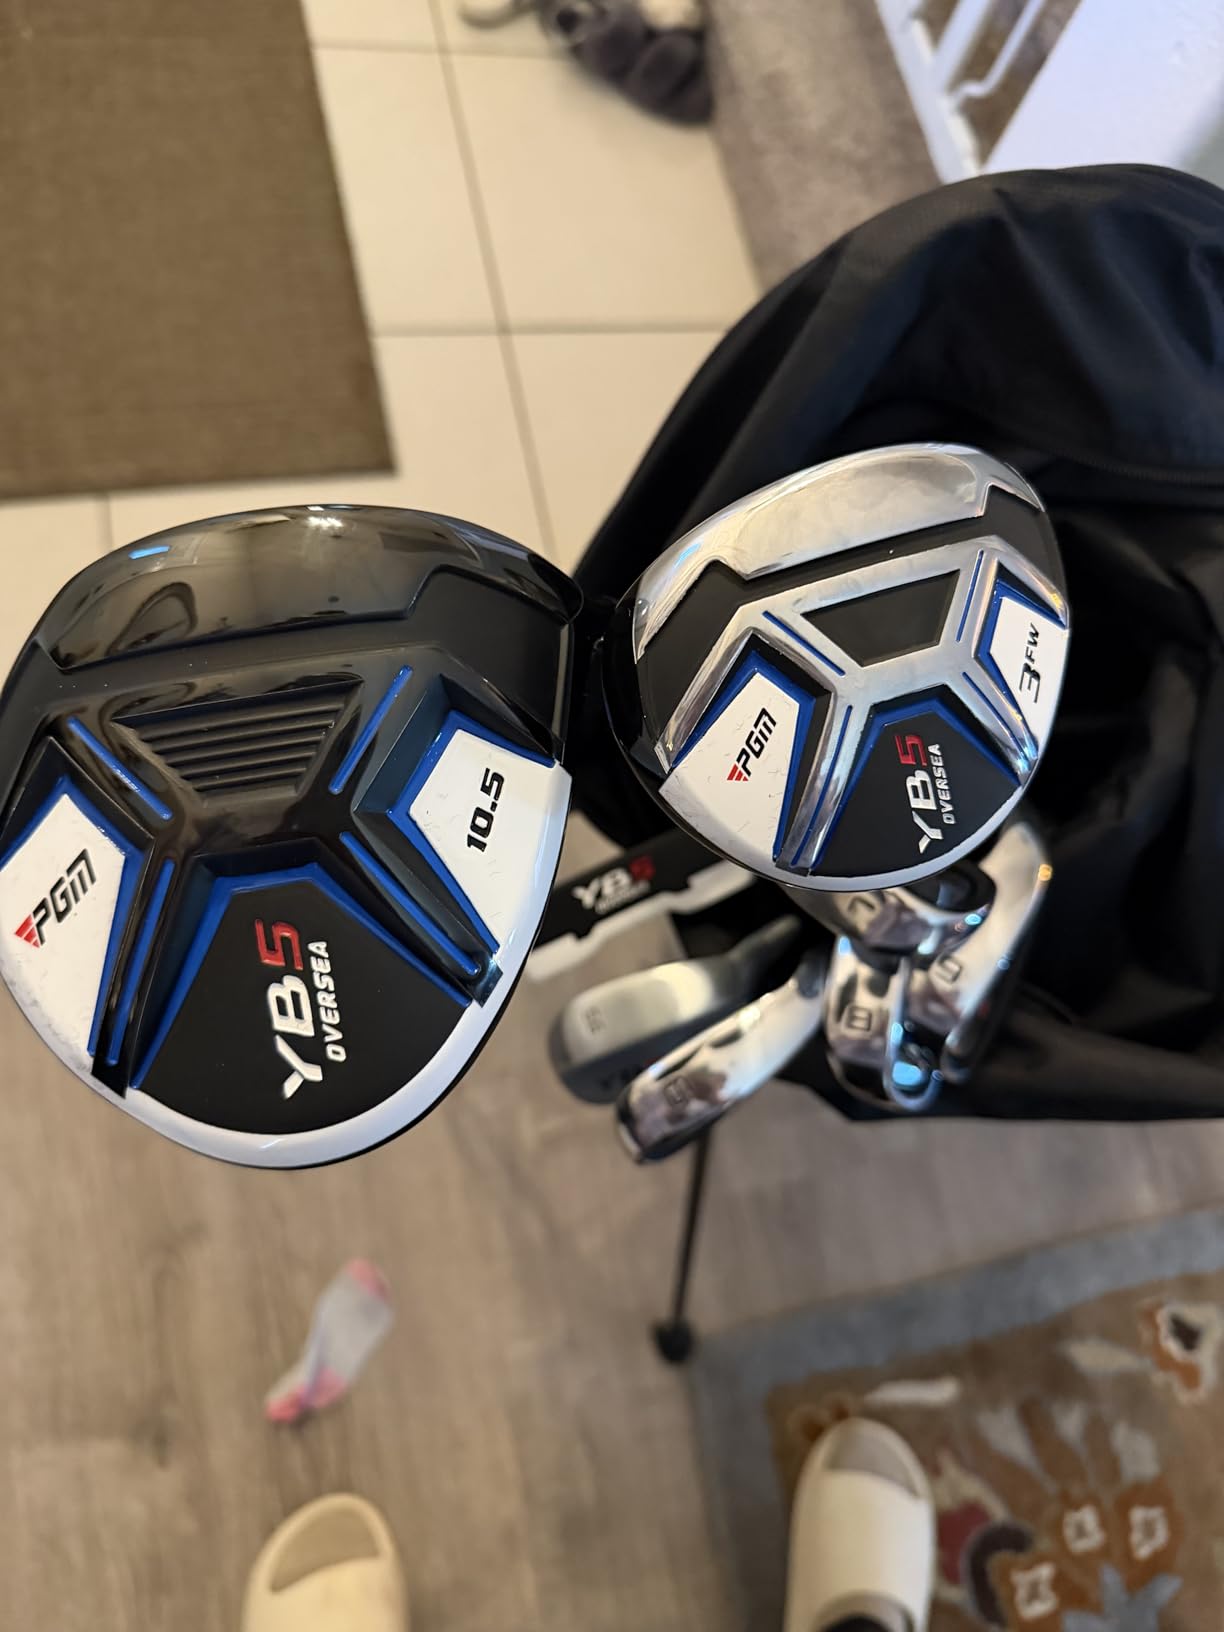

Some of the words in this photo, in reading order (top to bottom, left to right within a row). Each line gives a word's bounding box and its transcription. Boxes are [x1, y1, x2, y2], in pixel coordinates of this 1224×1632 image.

[1019, 622, 1041, 703] 3FW
[740, 706, 777, 782] PGM
[927, 743, 956, 825] OVERSEA
[466, 767, 505, 853] 10.5
[895, 735, 944, 854] YB5
[32, 848, 96, 948] PGM
[254, 918, 323, 1099] YB5
[310, 941, 347, 1062] OVERSEA
